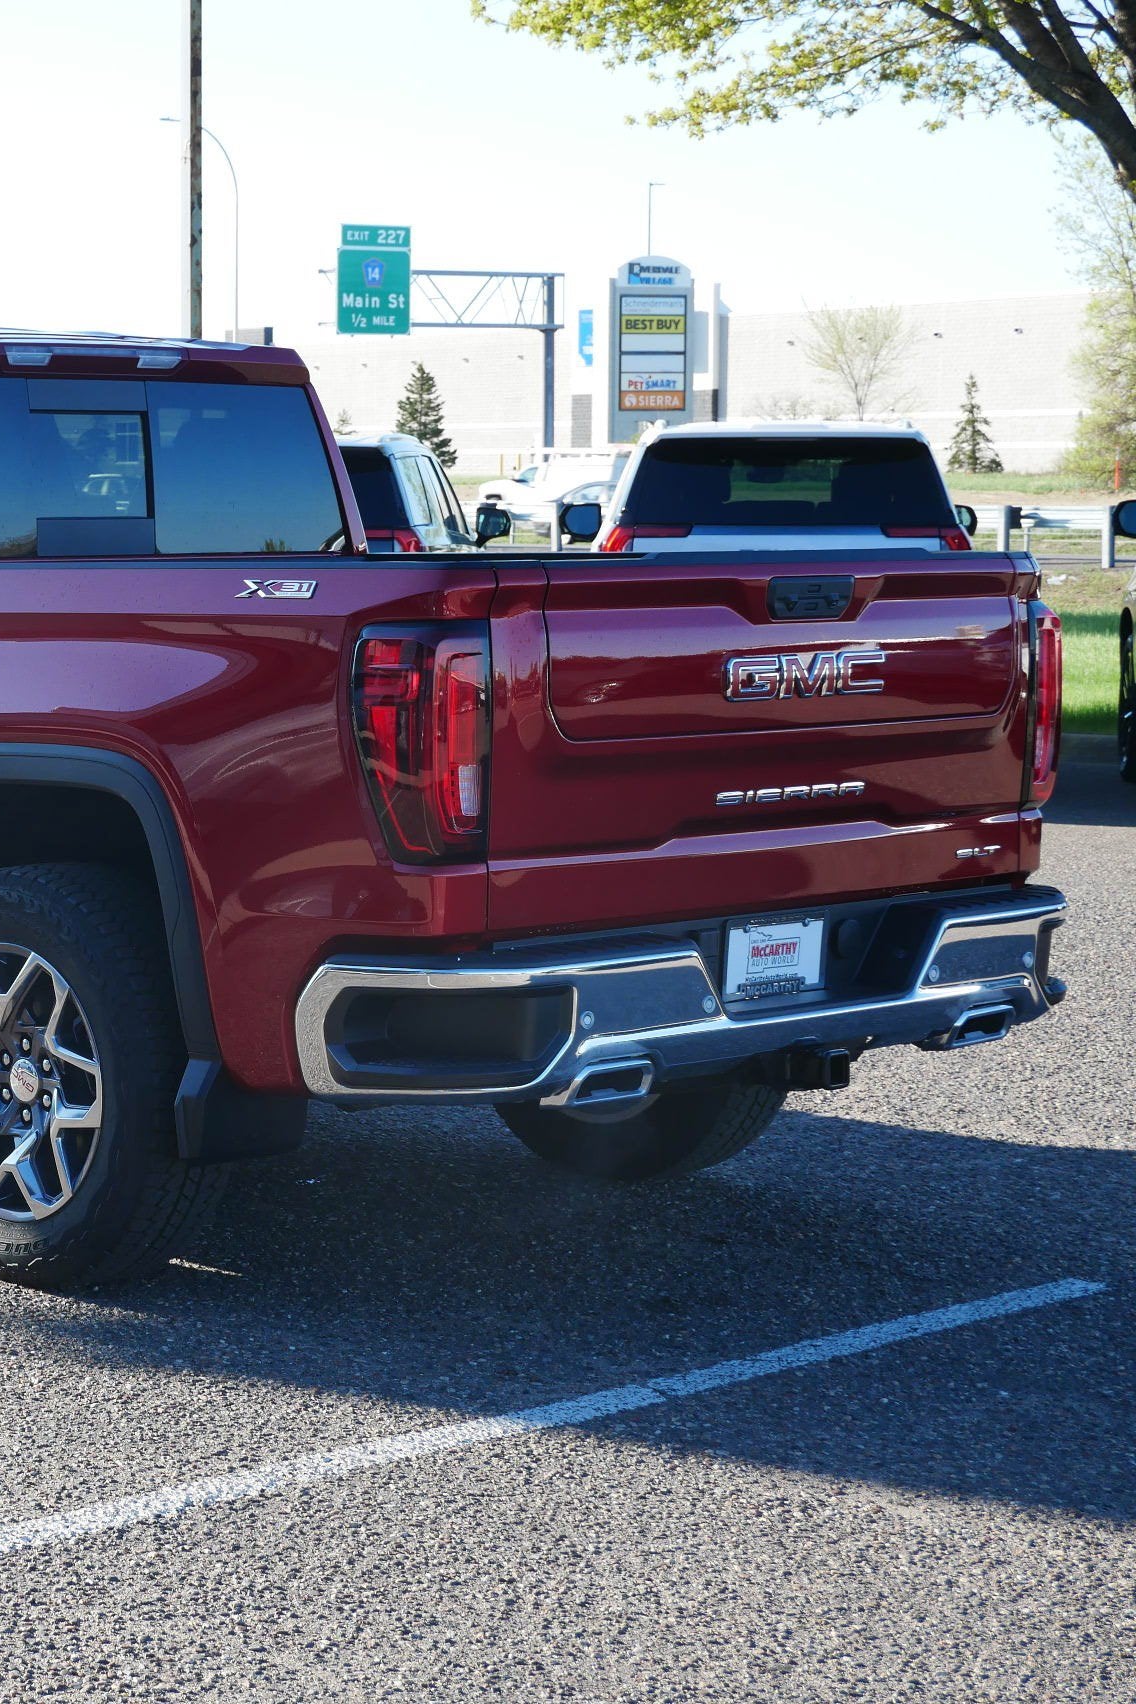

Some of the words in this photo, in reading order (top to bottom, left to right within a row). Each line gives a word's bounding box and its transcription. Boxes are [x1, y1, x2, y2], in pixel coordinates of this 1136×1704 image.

[347, 230, 370, 241] EXIT
[377, 230, 406, 245] 227
[367, 267, 380, 281] 14
[342, 293, 381, 309] Main
[388, 293, 406, 309] St
[372, 315, 397, 327] MILE
[625, 319, 654, 331] BEST
[656, 319, 681, 331] BUY
[638, 395, 681, 408] SIERRA
[723, 650, 886, 703] GMC
[715, 781, 866, 808] SIERRA
[955, 844, 1001, 859] SLT
[751, 956, 769, 968] AUTO
[770, 953, 795, 966] WORLD
[12, 1067, 35, 1093] GMC
